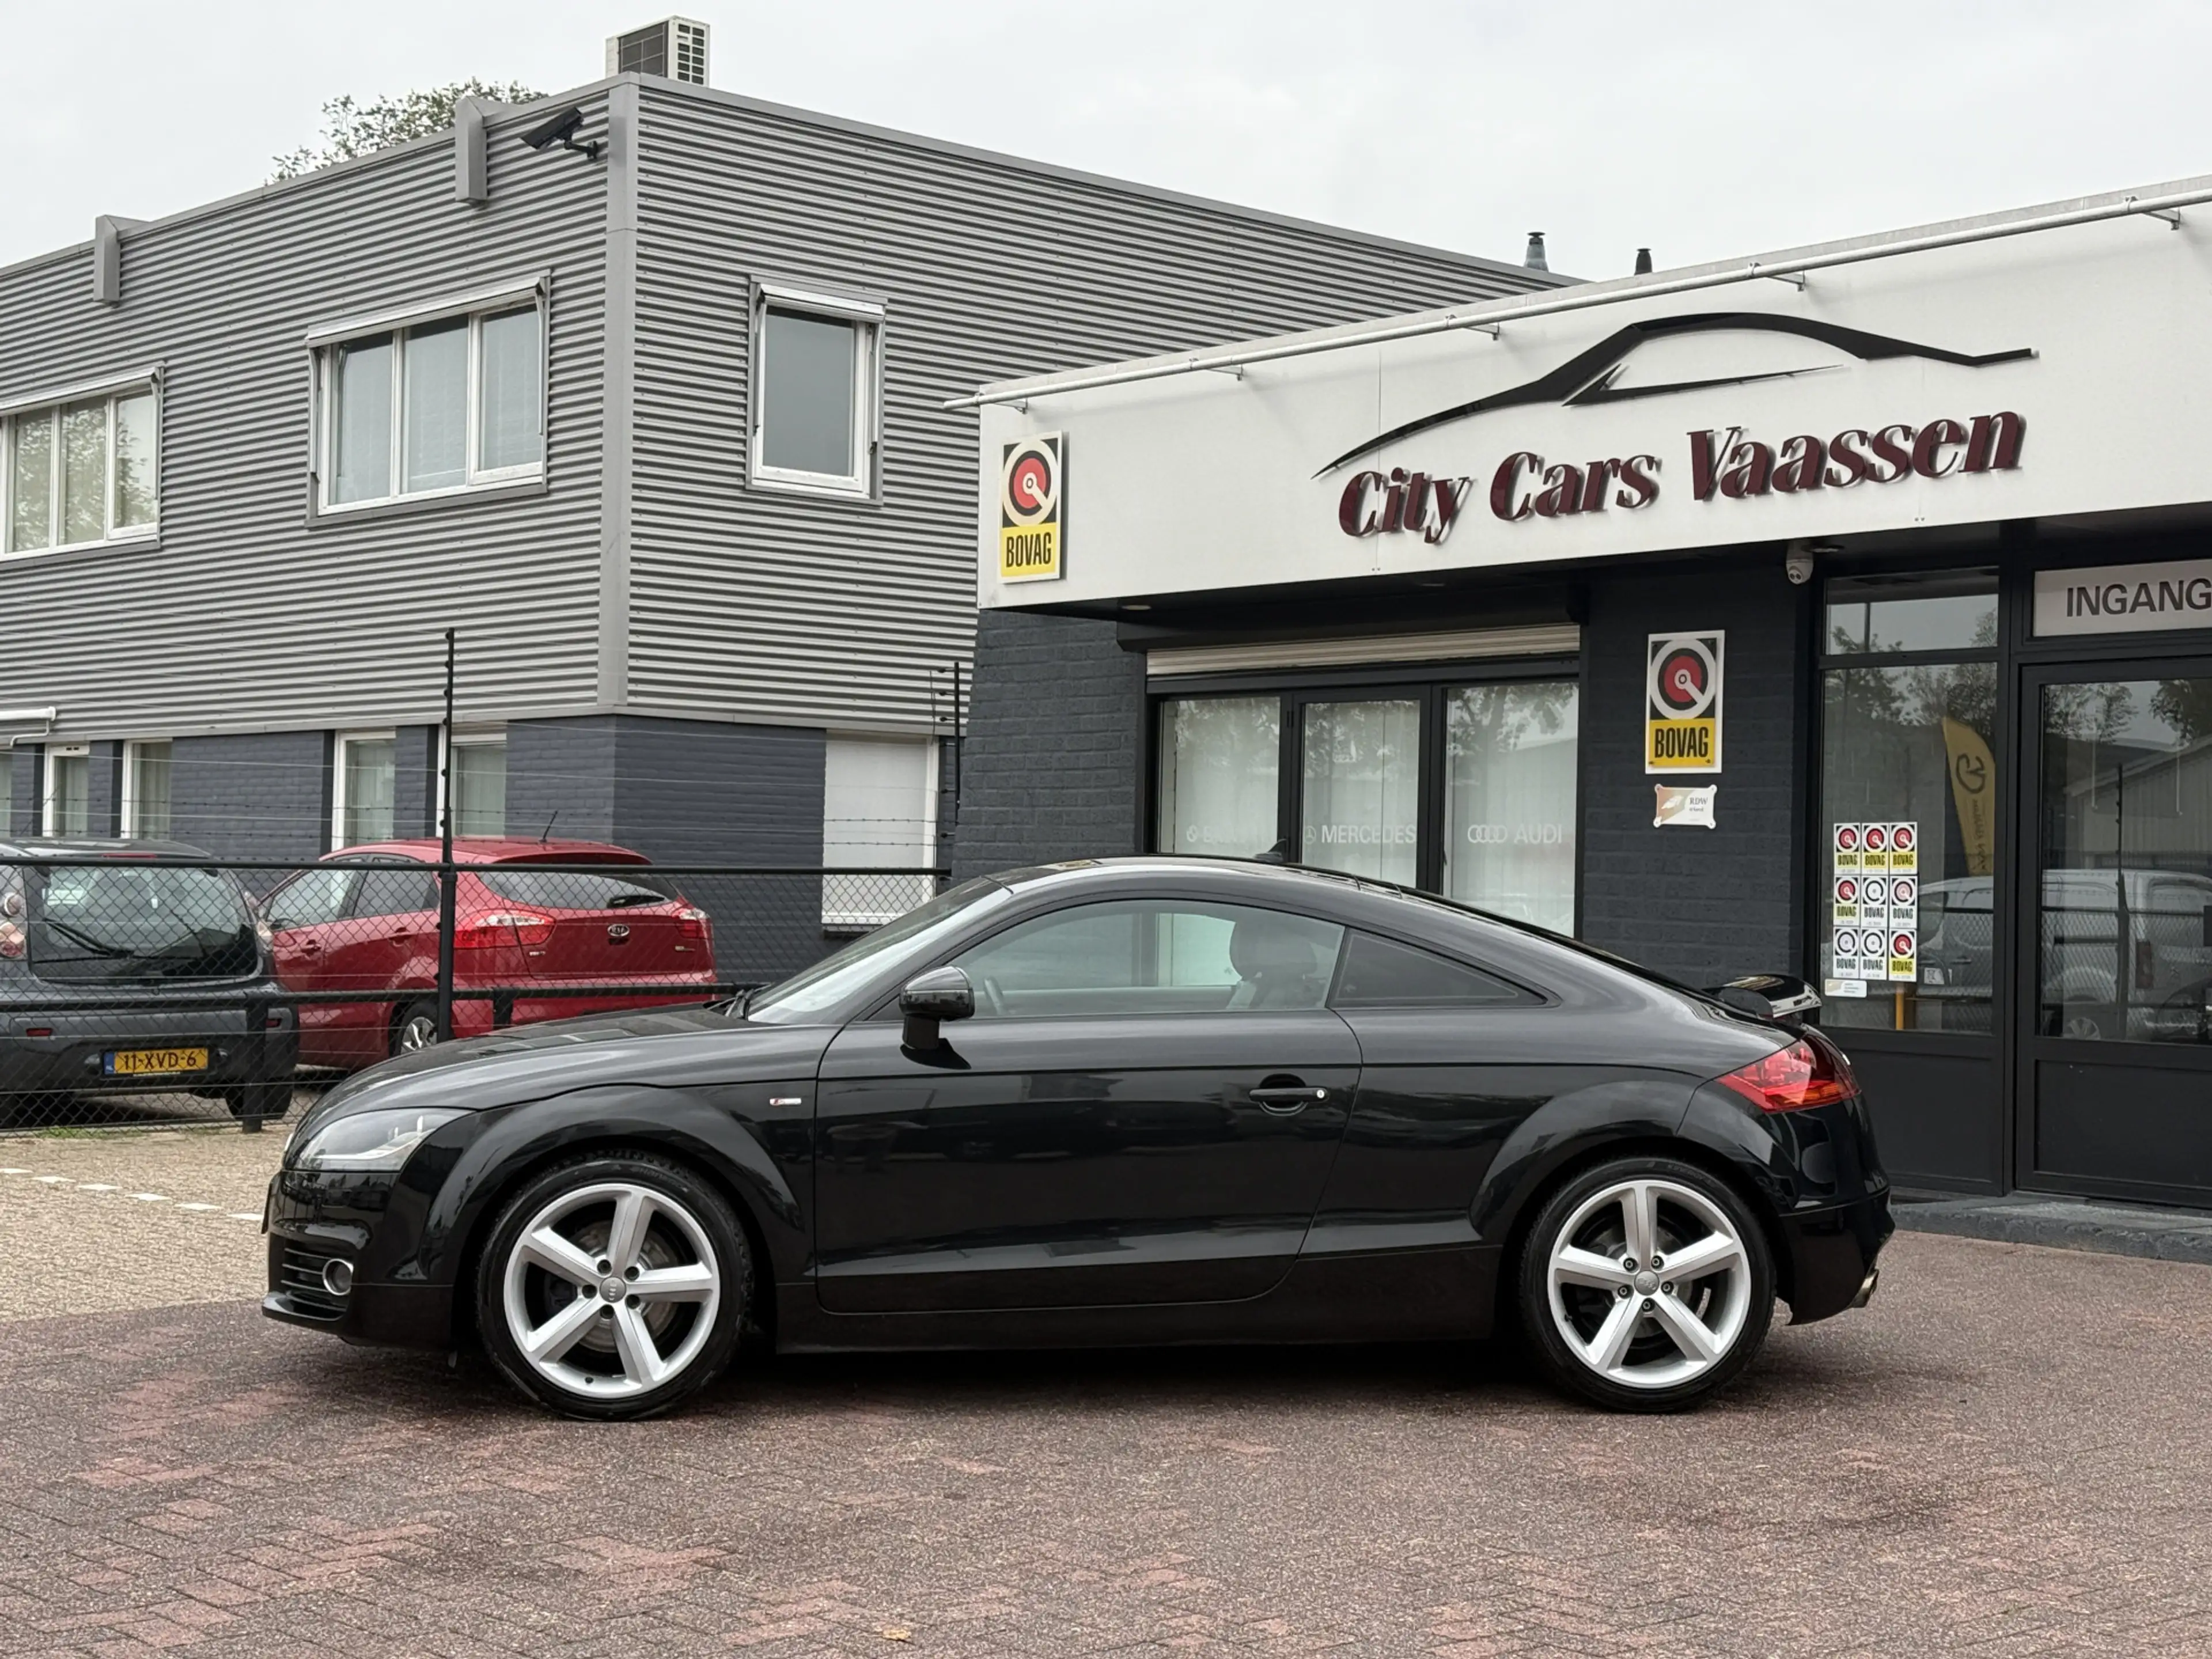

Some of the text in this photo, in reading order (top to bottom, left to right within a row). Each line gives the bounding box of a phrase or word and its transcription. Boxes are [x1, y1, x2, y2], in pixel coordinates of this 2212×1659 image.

[1339, 411, 2020, 544] City Cars Vaassen
[1006, 532, 1051, 568] BOVAG
[2067, 578, 2212, 617] INGANG
[1654, 726, 1709, 758] BOVAG
[1321, 824, 1416, 844] MERCEDES
[1513, 823, 1562, 844] AUDI
[1838, 854, 1858, 865] BOVAG
[1865, 854, 1885, 866] BOVAG
[1893, 854, 1914, 866] BOVAG
[1836, 906, 1857, 917] BOVAG
[1864, 907, 1884, 918] BOVAG
[1893, 908, 1914, 919] BOVAG
[1836, 958, 1856, 969] BOVAG
[1863, 959, 1883, 971] BOVAG
[1892, 960, 1912, 972] BOVAG
[124, 1051, 196, 1070] 11-XVD-6
